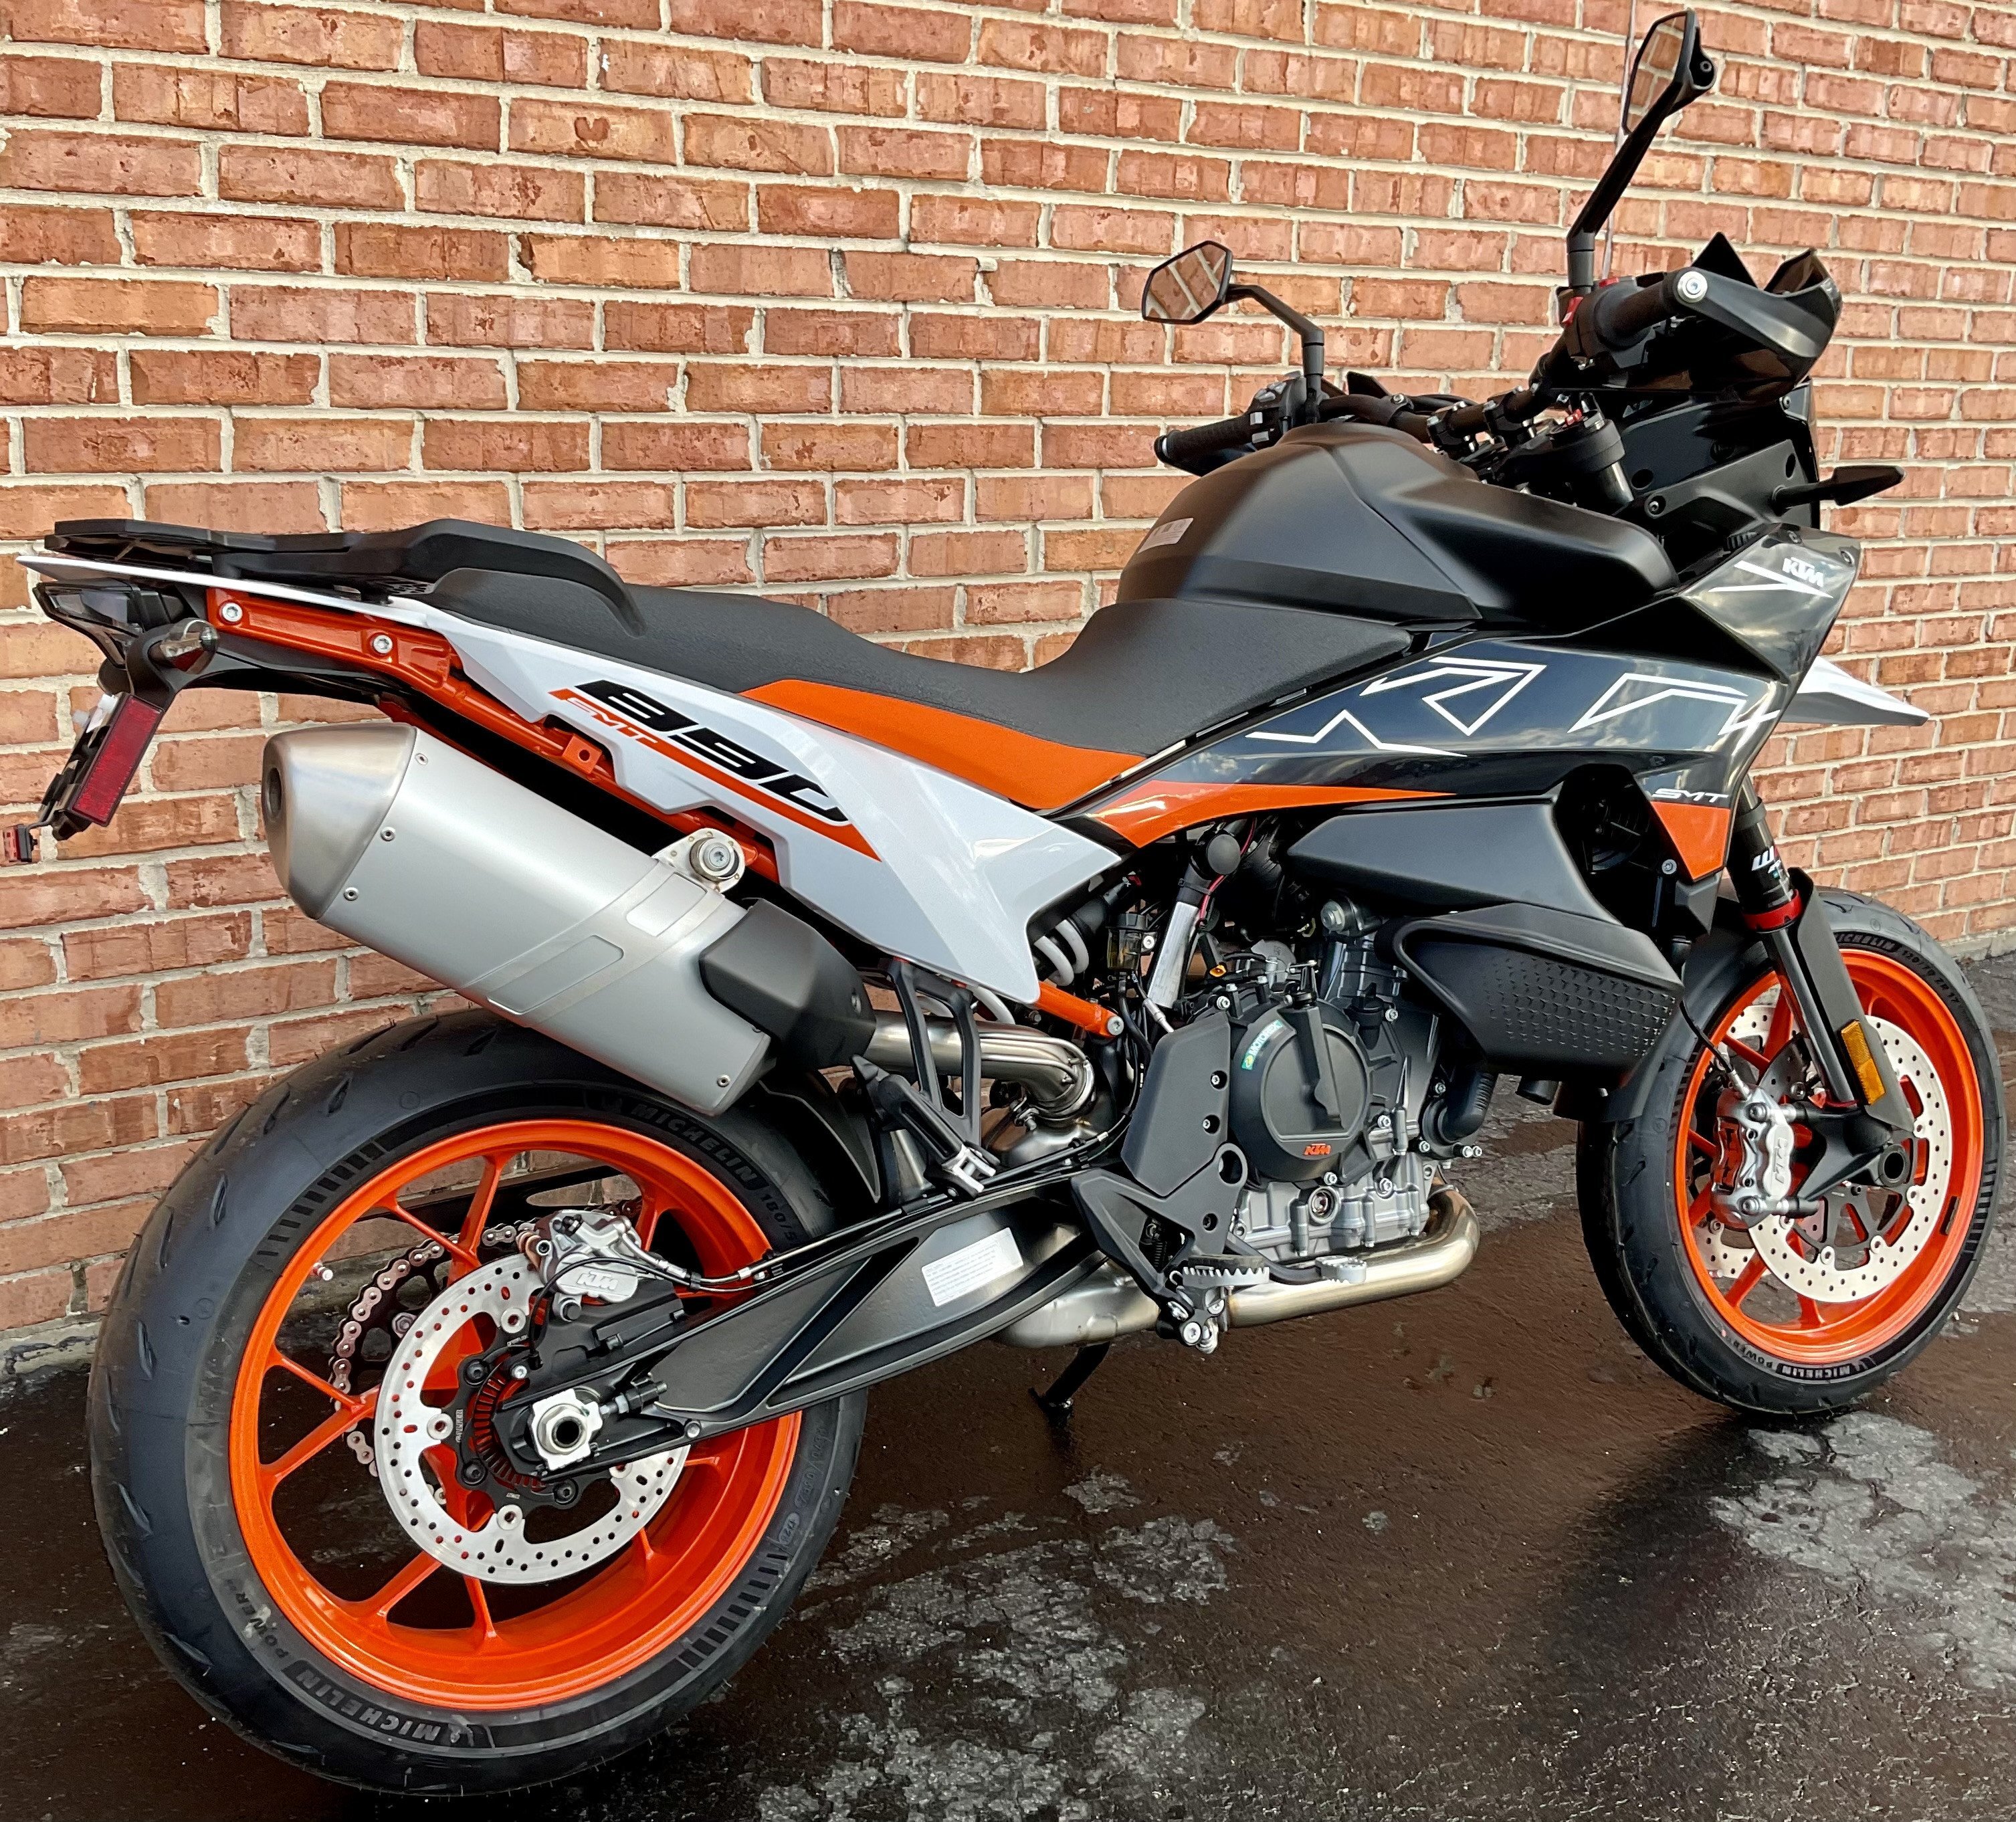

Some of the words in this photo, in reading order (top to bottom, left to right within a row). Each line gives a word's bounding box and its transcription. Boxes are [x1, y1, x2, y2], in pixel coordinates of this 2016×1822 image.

[1782, 556, 1824, 588] KTM
[567, 696, 659, 744] SMT
[1651, 788, 1729, 803] SMT
[631, 1104, 758, 1183] MICHELIN
[1303, 1142, 1332, 1156] KTM
[577, 1270, 619, 1291] KTM
[1781, 1364, 1851, 1379] MICHELIN
[235, 1592, 289, 1659] POWER
[295, 1669, 442, 1742] MICHELIN
